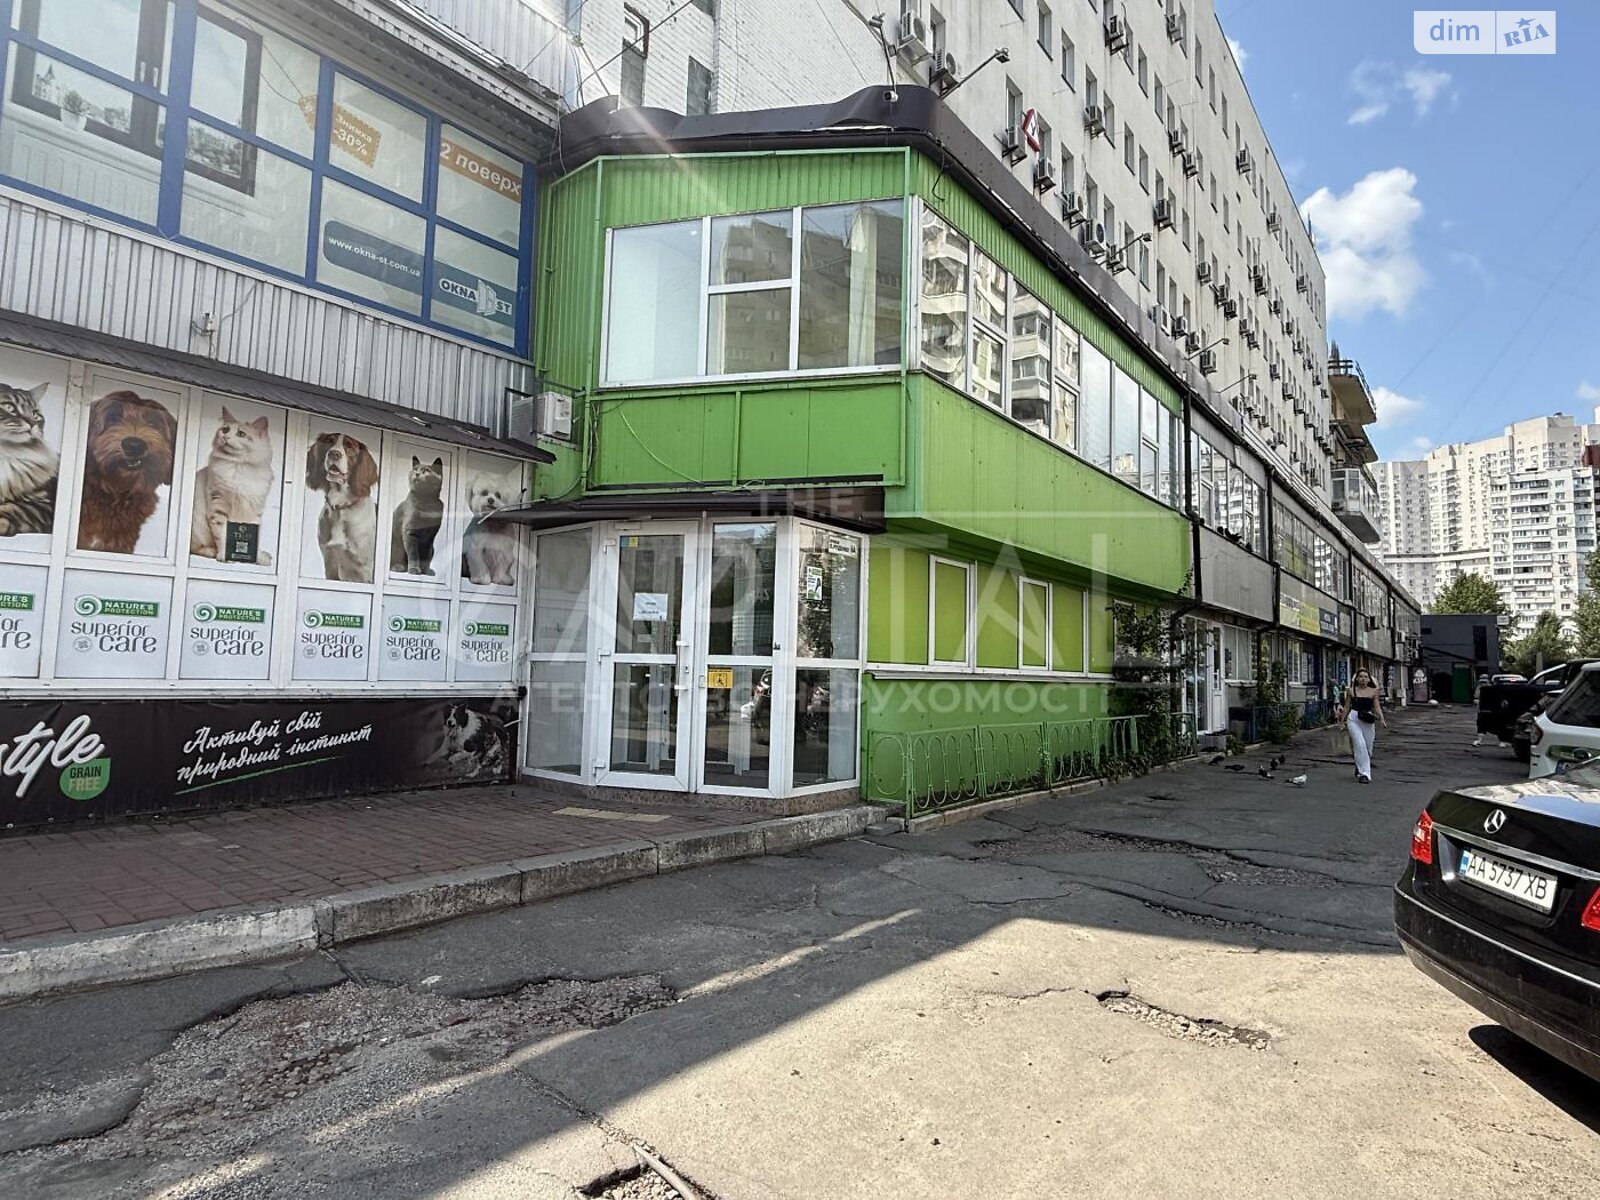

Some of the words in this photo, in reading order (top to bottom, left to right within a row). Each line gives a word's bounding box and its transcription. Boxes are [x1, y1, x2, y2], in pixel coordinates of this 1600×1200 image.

[335, 113, 372, 144] Знижка
[332, 127, 368, 157] -30%
[440, 142, 452, 160] 2
[456, 154, 522, 197] поверх
[328, 236, 421, 278] www.okna-st.com.ua
[440, 279, 477, 302] OKNA
[496, 300, 512, 316] ST
[105, 600, 154, 610] NATURE'S
[218, 608, 261, 617] NATURE'S
[0, 614, 24, 631] or
[325, 615, 360, 623] NATURE'S
[71, 620, 150, 637] superior
[190, 625, 259, 641] superior
[99, 635, 157, 653] care
[301, 631, 357, 645] superior
[386, 635, 435, 648] superior
[461, 638, 504, 651] superior
[214, 639, 264, 656] care
[321, 643, 363, 658] care
[403, 646, 441, 661] care
[476, 648, 509, 662] care
[183, 719, 280, 754] Активуй
[285, 711, 322, 735] свій
[177, 743, 282, 785] природний
[285, 724, 373, 756] інстинкт
[70, 766, 102, 779] GRAIN
[68, 777, 101, 792] FREE
[1489, 860, 1524, 890] 5737
